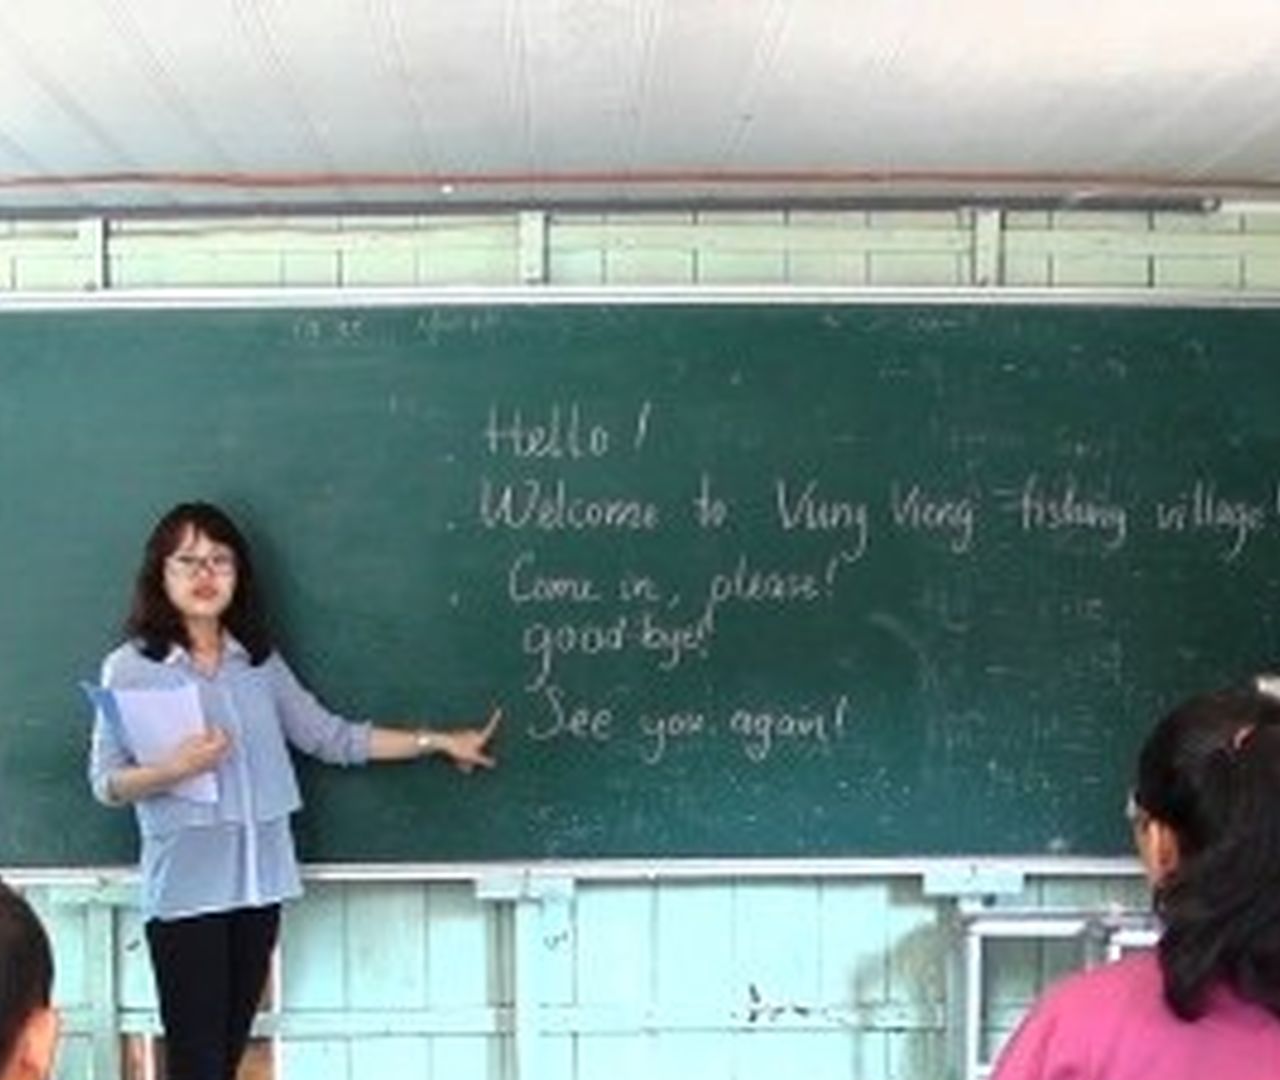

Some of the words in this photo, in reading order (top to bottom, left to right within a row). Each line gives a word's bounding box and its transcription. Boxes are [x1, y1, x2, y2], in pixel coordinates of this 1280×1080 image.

[478, 477, 658, 530] Welcome
[692, 472, 725, 527] to
[509, 553, 600, 602] Come
[526, 683, 613, 740] See
